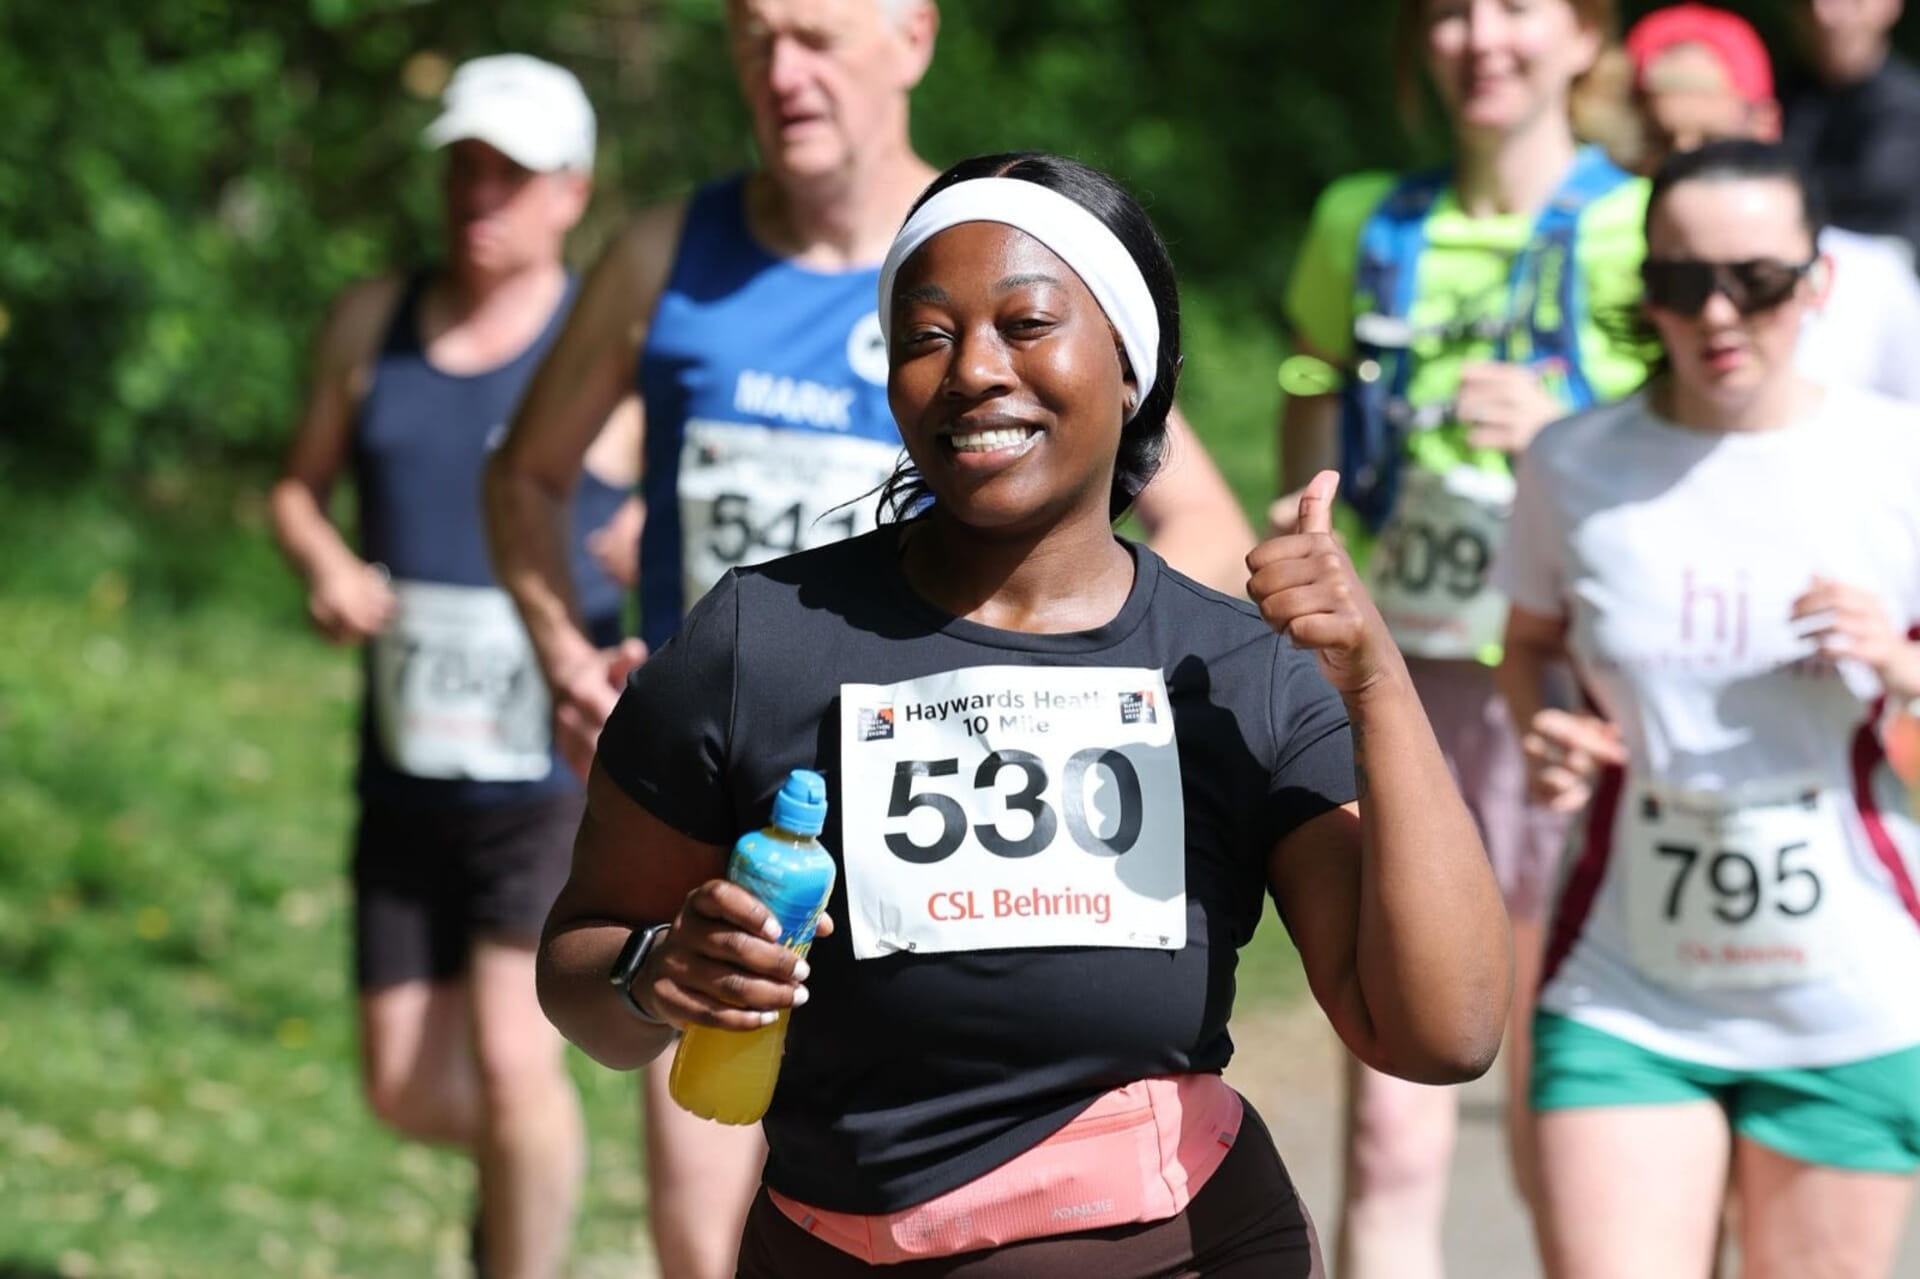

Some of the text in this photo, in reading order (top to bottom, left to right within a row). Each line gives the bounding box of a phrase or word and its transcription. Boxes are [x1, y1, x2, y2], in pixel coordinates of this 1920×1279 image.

[734, 369, 856, 431] MARK
[906, 691, 1025, 721] Haywards
[963, 716, 989, 737] 10
[884, 747, 1143, 864] 530
[928, 887, 1111, 924] CSL Behring
[1655, 840, 1821, 925] 795
